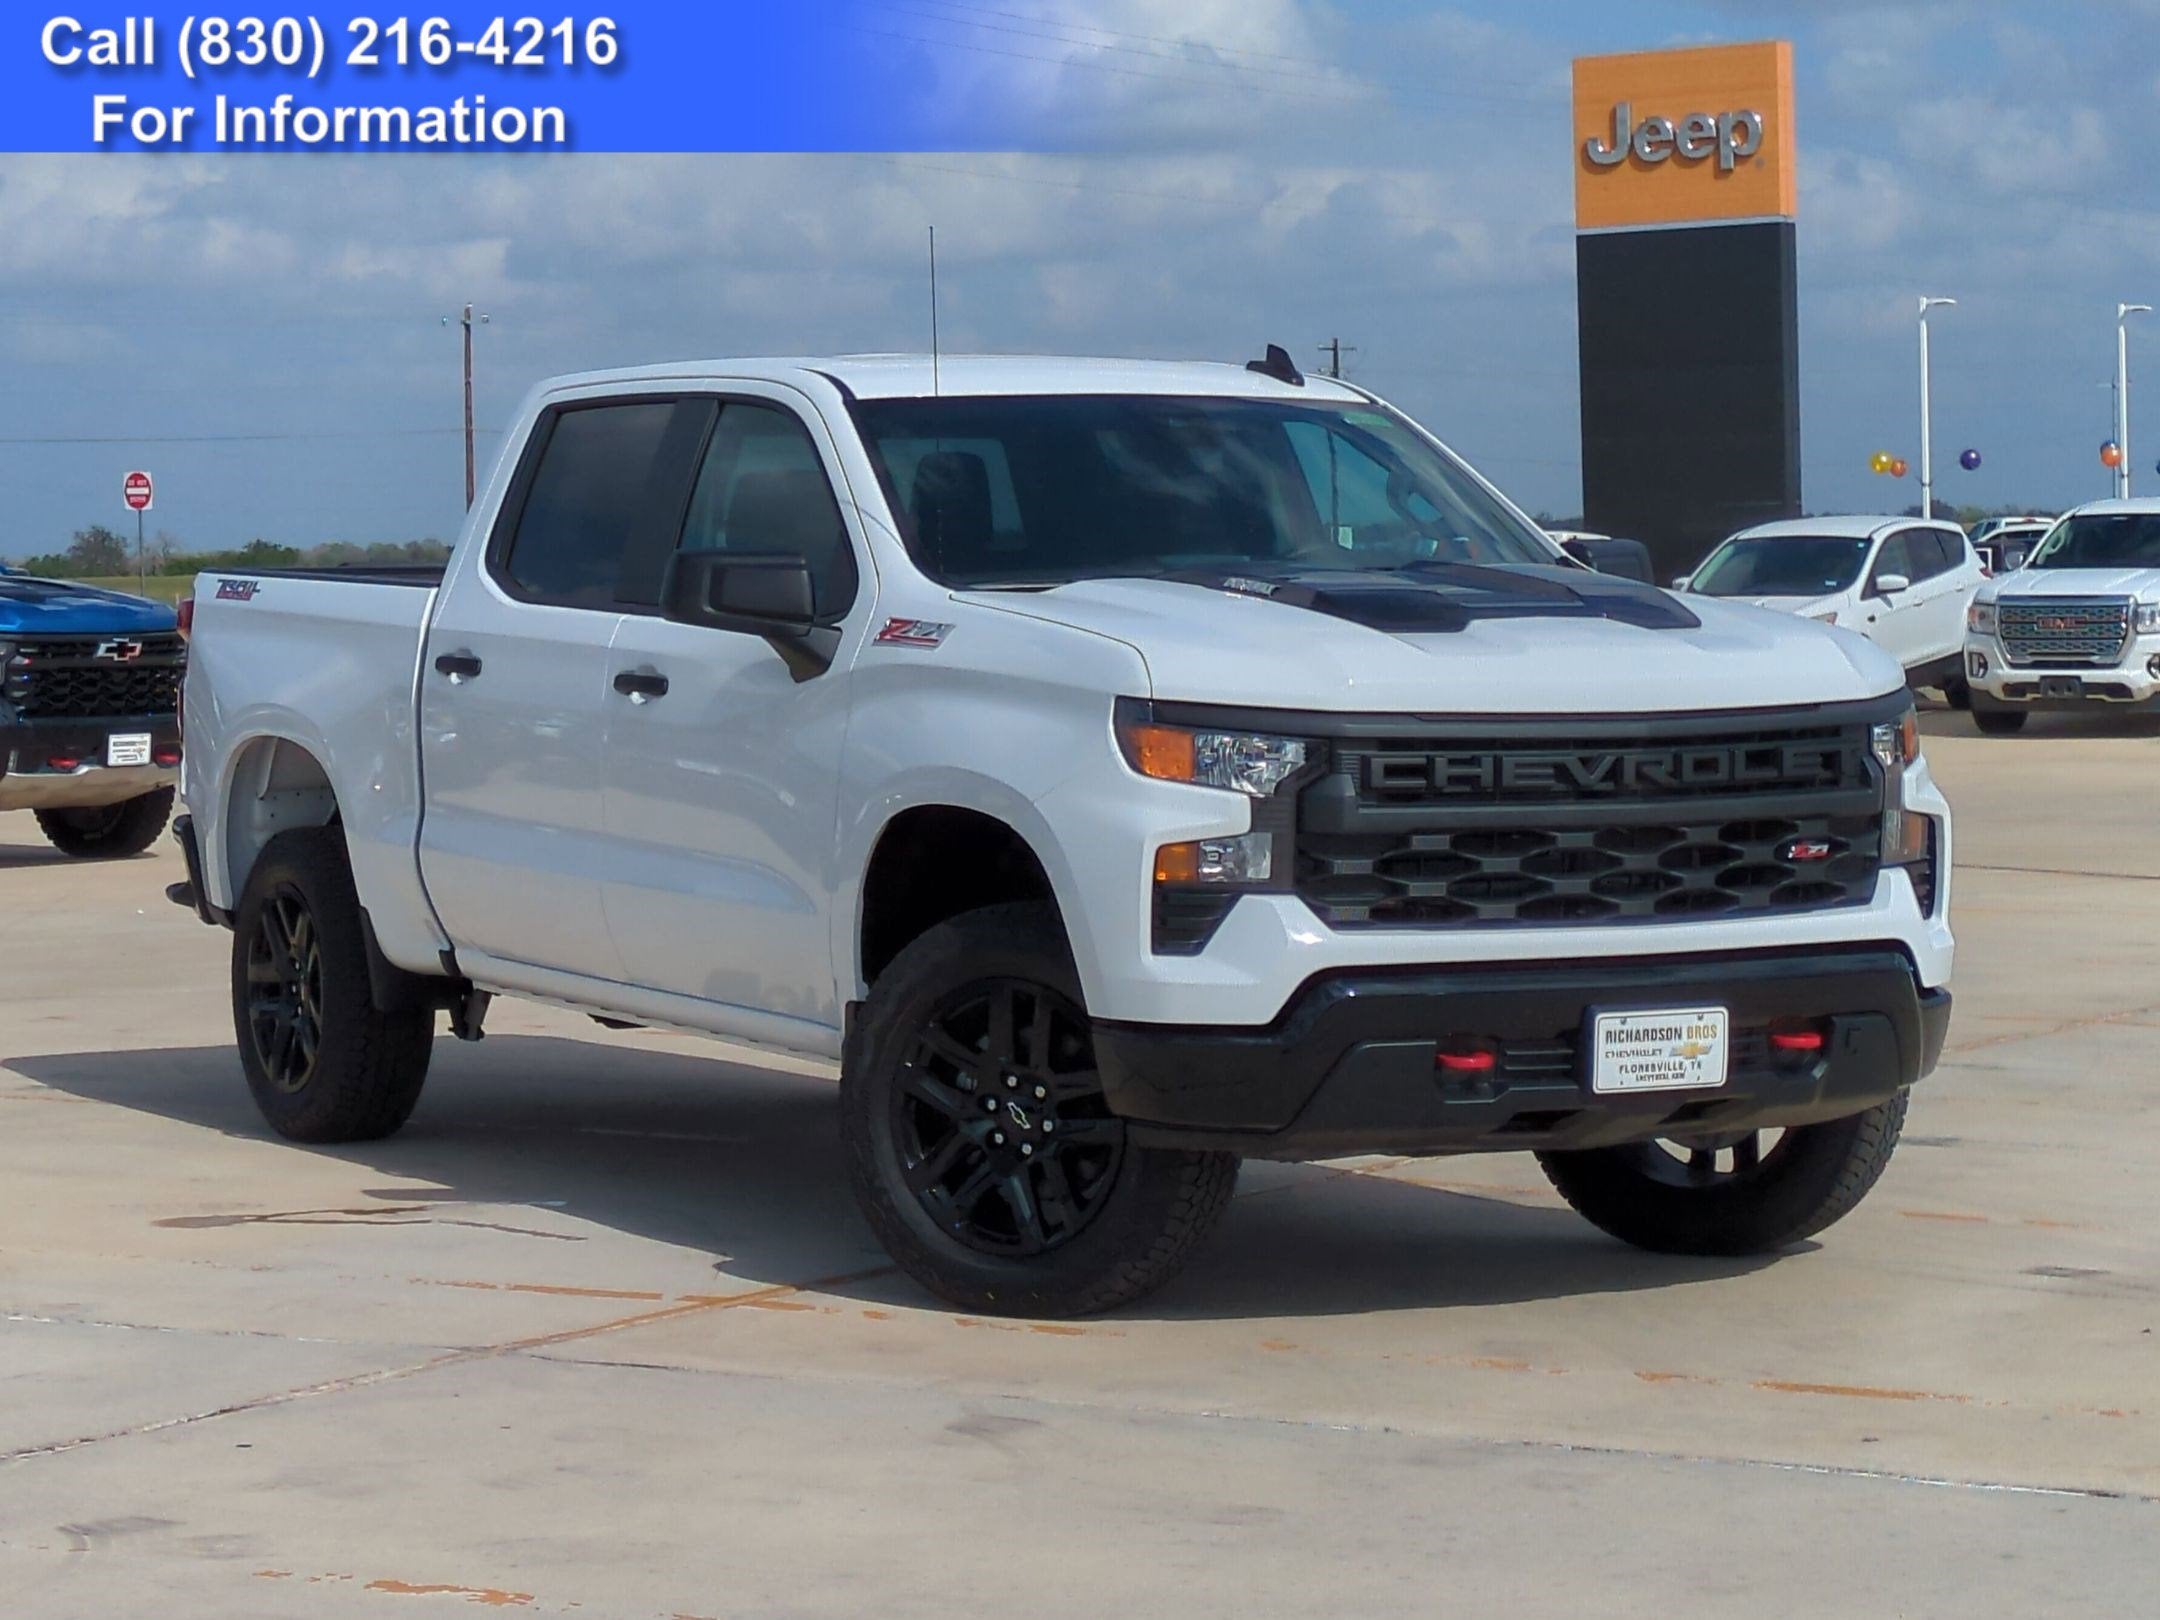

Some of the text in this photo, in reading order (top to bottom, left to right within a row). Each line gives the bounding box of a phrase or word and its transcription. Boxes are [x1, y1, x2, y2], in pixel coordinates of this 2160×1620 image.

[1586, 102, 1763, 170] Jeep
[1605, 1023, 1718, 1044] RICHARDSON BROS
